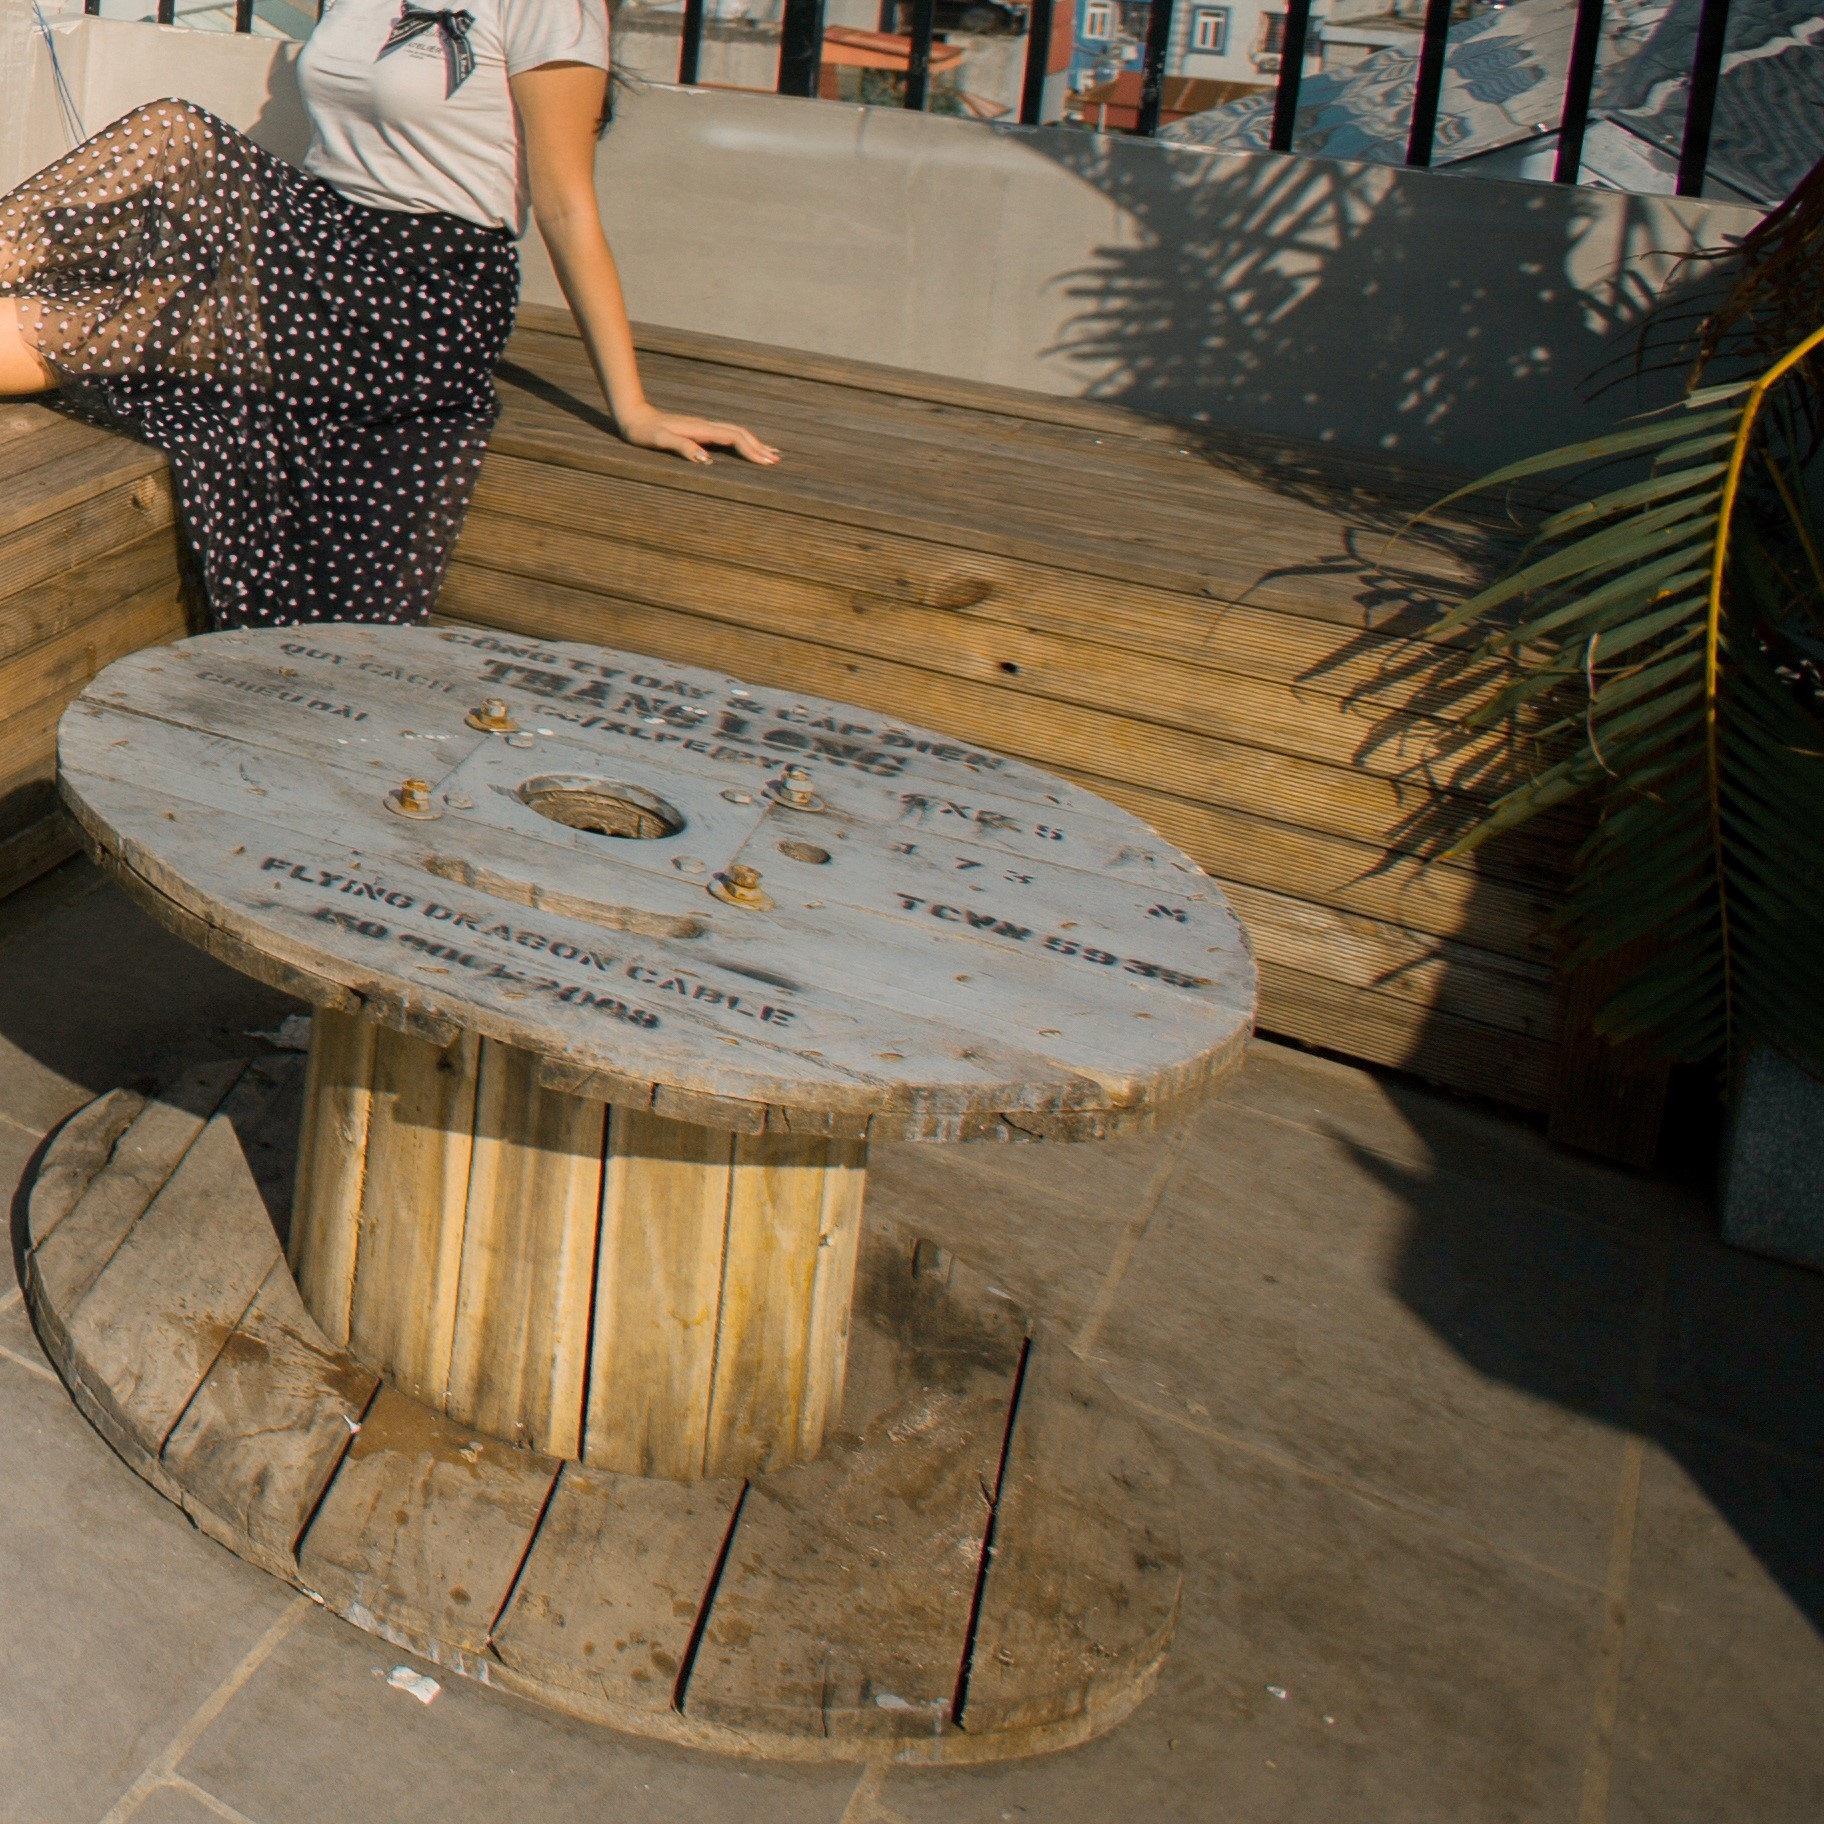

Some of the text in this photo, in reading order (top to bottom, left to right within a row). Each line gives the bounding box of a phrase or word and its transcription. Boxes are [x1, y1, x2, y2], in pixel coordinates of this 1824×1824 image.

[260, 855, 796, 1028] FLYING DRAGON CABLE
